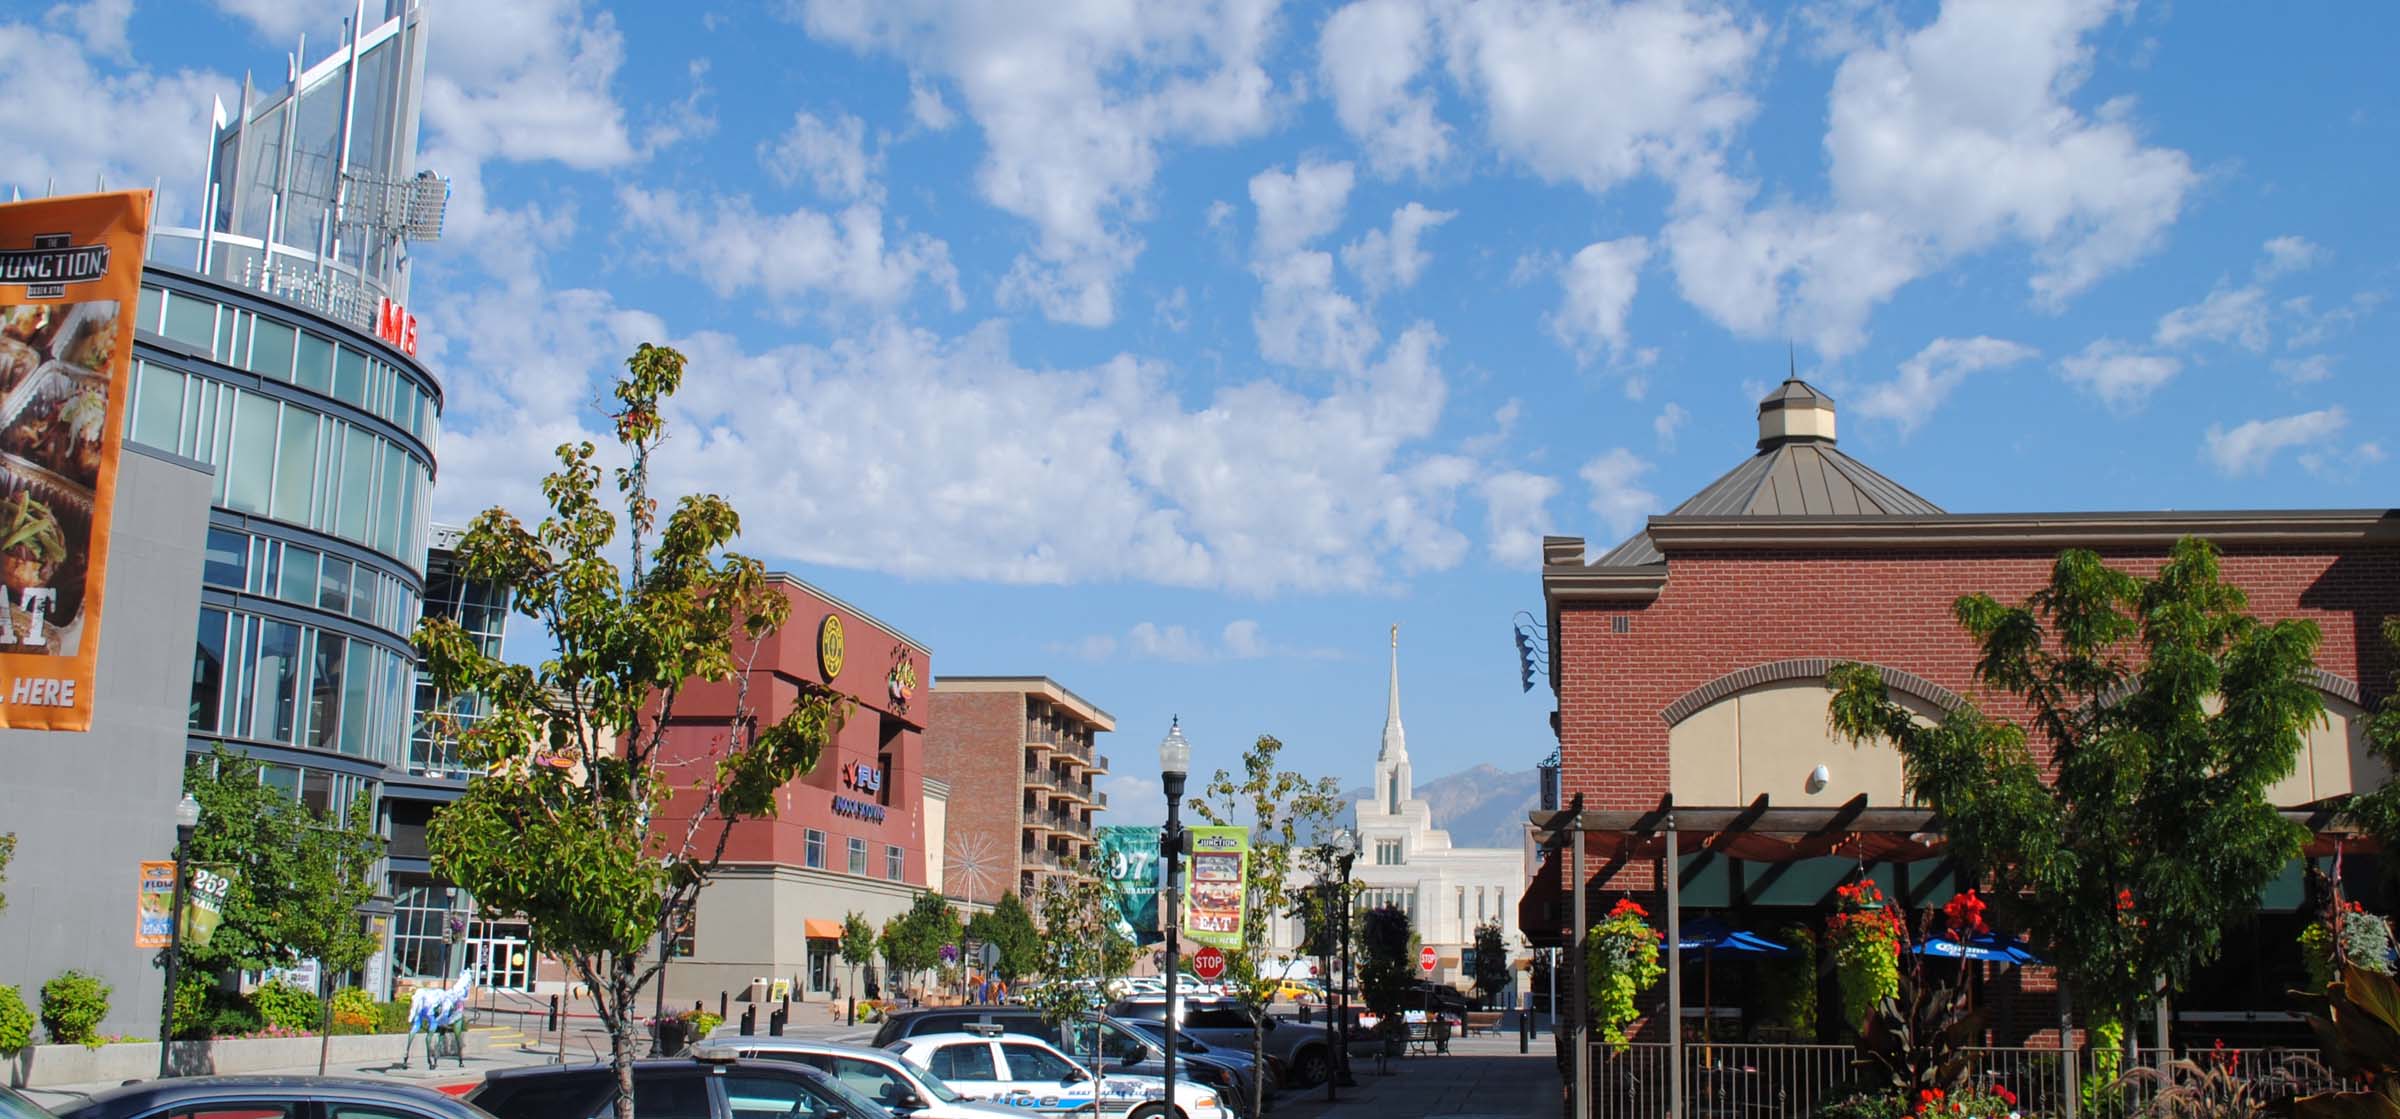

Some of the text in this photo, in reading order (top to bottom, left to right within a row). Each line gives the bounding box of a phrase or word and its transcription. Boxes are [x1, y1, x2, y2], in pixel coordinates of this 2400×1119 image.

[0, 584, 57, 646] AT
[11, 677, 76, 707] HERE
[1111, 851, 1148, 880] 97
[193, 869, 229, 898] 252
[1199, 914, 1232, 931] EAT
[1195, 955, 1222, 969] STOP
[1420, 953, 1437, 964] STOP
